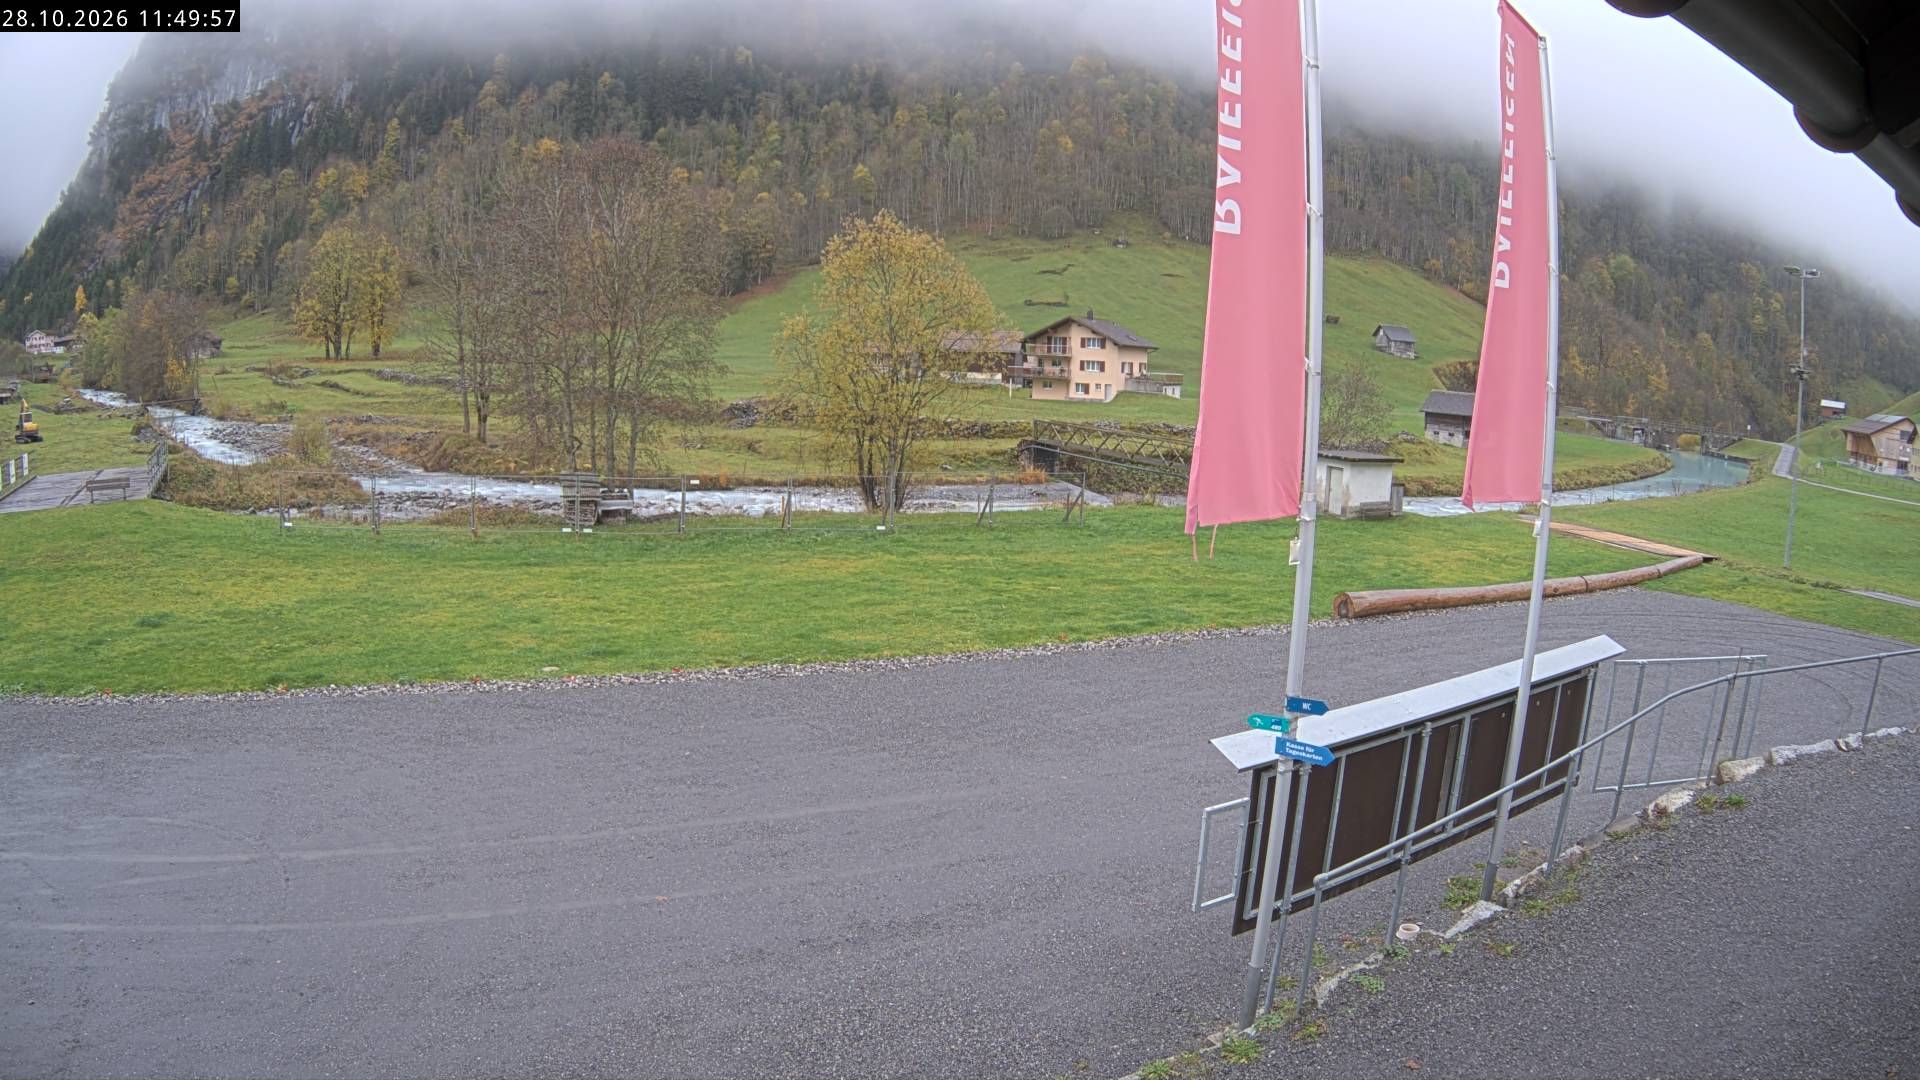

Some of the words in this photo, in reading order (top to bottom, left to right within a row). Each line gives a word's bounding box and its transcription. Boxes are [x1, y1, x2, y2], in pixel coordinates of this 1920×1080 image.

[1302, 702, 1312, 711] WC
[1286, 741, 1305, 751] Kasse
[1286, 747, 1323, 760] Tageskarten
